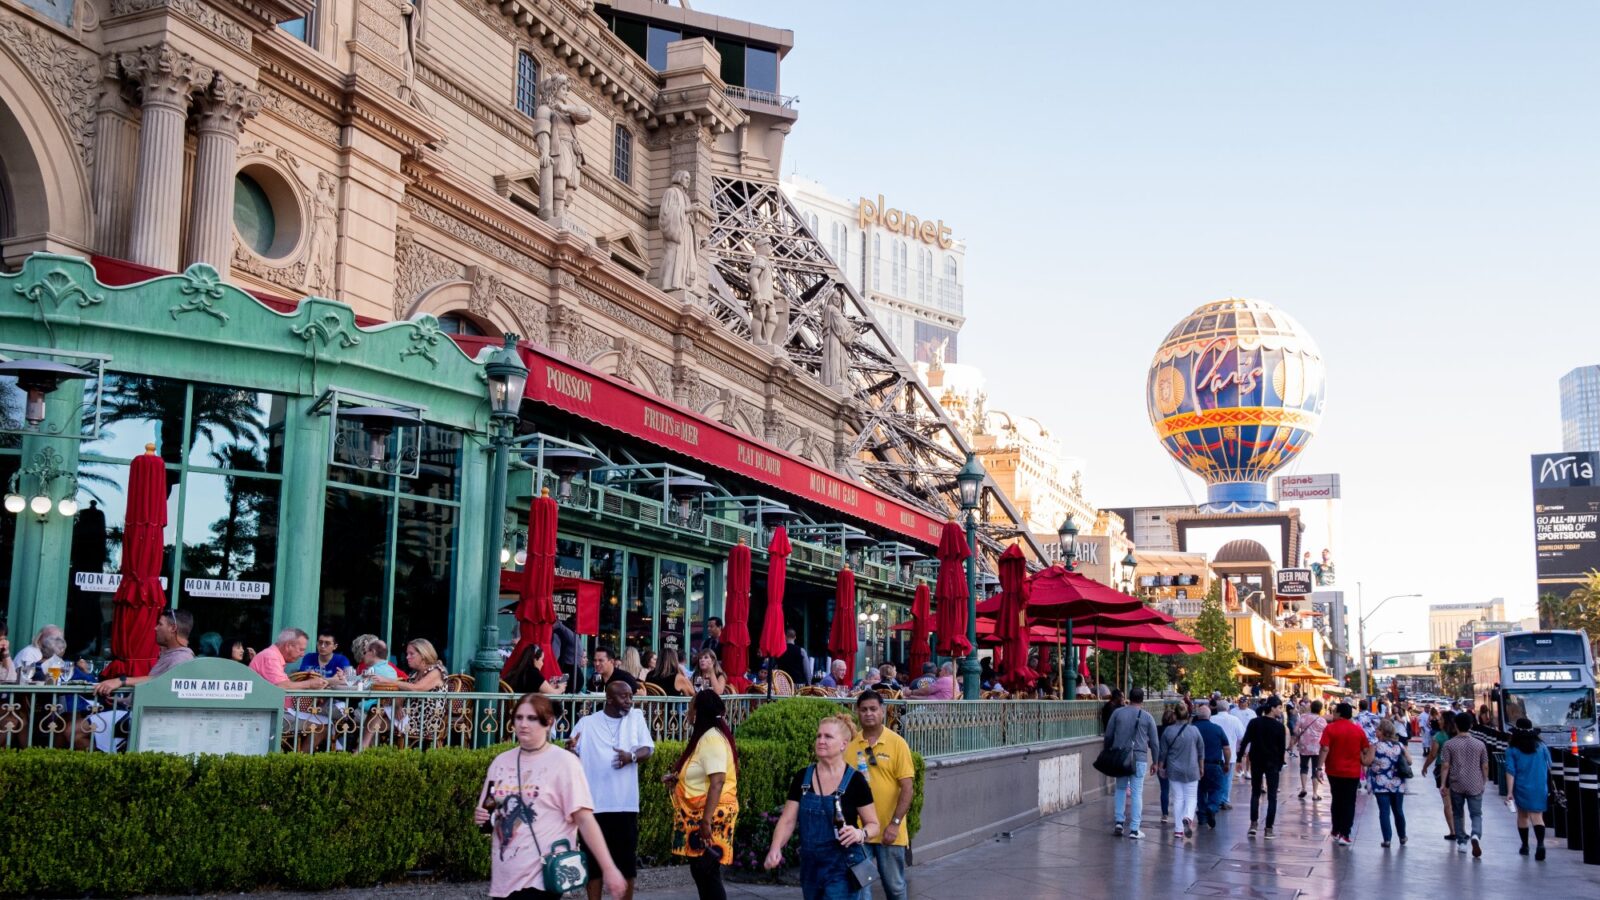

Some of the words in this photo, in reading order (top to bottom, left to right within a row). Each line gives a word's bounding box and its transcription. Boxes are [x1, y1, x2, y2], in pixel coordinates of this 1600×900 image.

[860, 194, 952, 250] planet
[1191, 335, 1264, 417] Paris
[546, 366, 592, 403] POISSON
[644, 406, 674, 436] FRUITS
[681, 422, 698, 445] MER
[738, 444, 754, 466] PLAT
[755, 450, 765, 470] DU
[766, 457, 781, 477] JOUR
[1540, 456, 1593, 483] Aria
[1282, 476, 1313, 487] planet
[810, 472, 826, 495] MON
[828, 480, 840, 500] AMI
[842, 486, 858, 507] GABI
[1282, 488, 1329, 498] hollywood
[1578, 515, 1597, 523] WITH
[1575, 523, 1586, 531] OF
[1537, 531, 1597, 540] SPORTSBOOKS
[1075, 542, 1099, 565] ARK
[77, 573, 103, 584] MON
[1279, 571, 1294, 583] BEER
[1294, 571, 1310, 583] PARK
[186, 580, 211, 590] MON
[215, 581, 235, 591] AMI
[239, 582, 265, 593] GABI
[1514, 671, 1536, 681] DEUCE
[174, 680, 197, 690] MON
[201, 681, 220, 690] AMI
[223, 681, 248, 691] GABI
